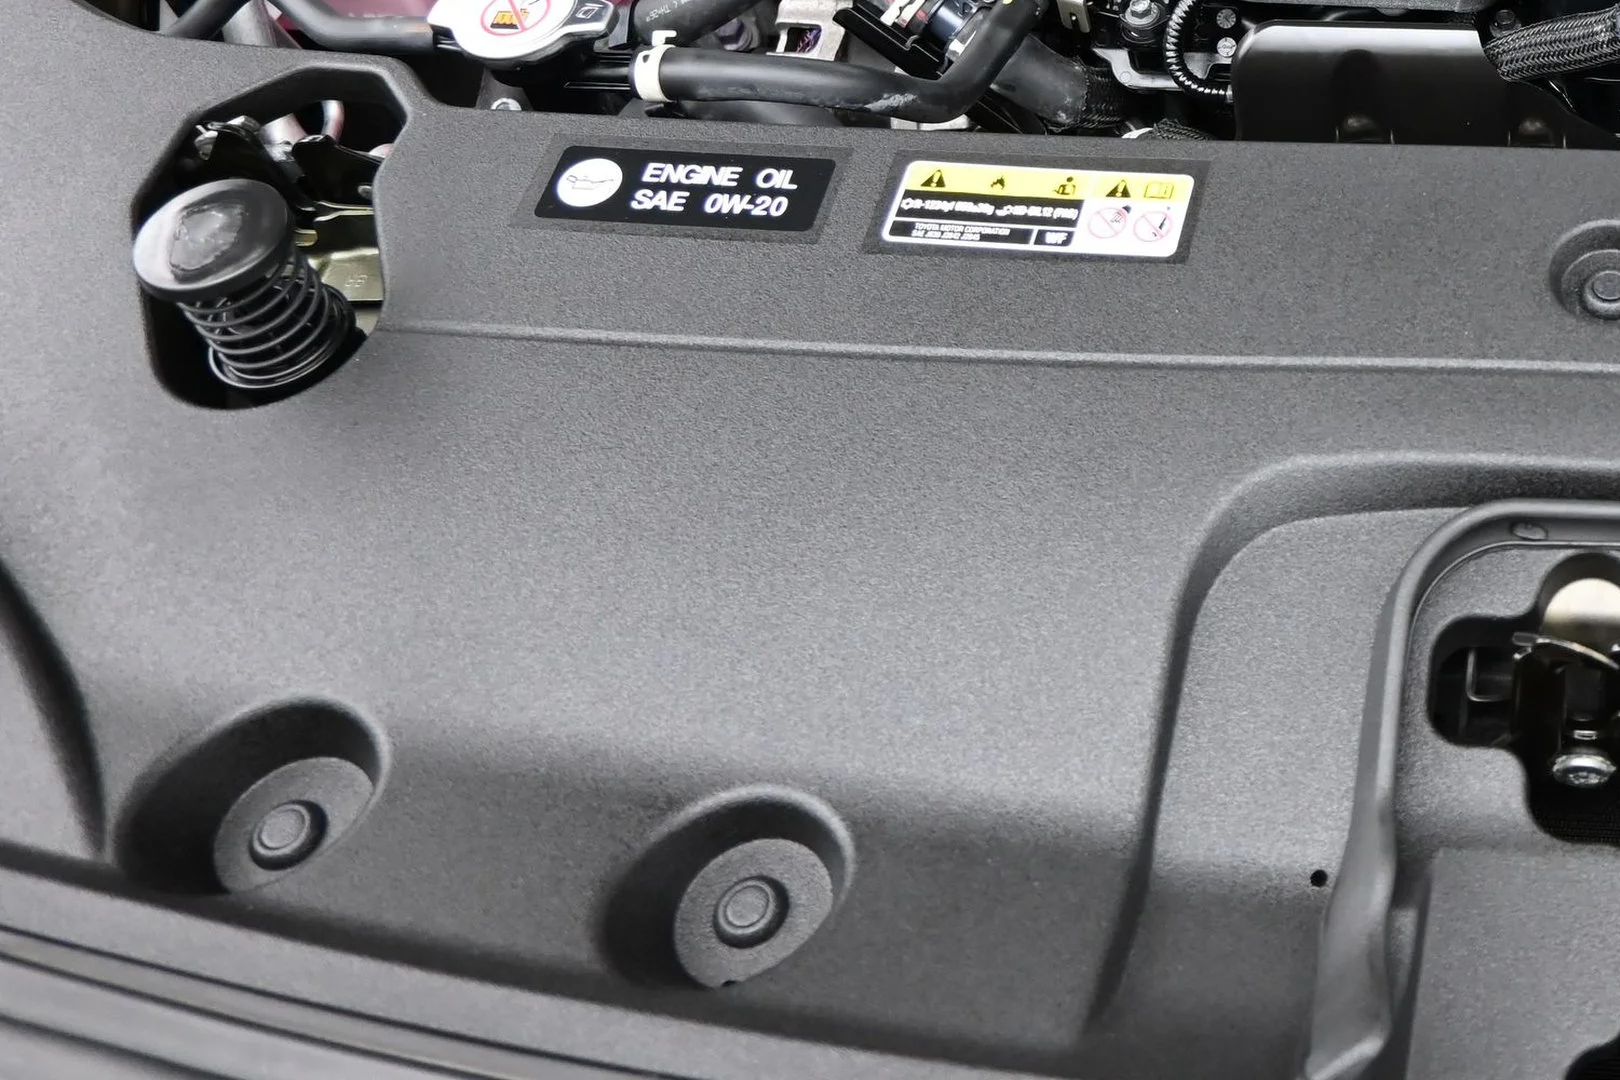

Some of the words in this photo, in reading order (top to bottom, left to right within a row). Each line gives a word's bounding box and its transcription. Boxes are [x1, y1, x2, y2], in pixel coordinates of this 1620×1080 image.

[640, 162, 743, 187] ENGINE
[755, 168, 798, 190] OIL
[630, 189, 690, 212] SAE
[703, 193, 789, 217] 0W-20
[915, 223, 939, 231] TOYOTA
[940, 224, 964, 233] MOTOR
[964, 226, 1011, 235] CORPORATION
